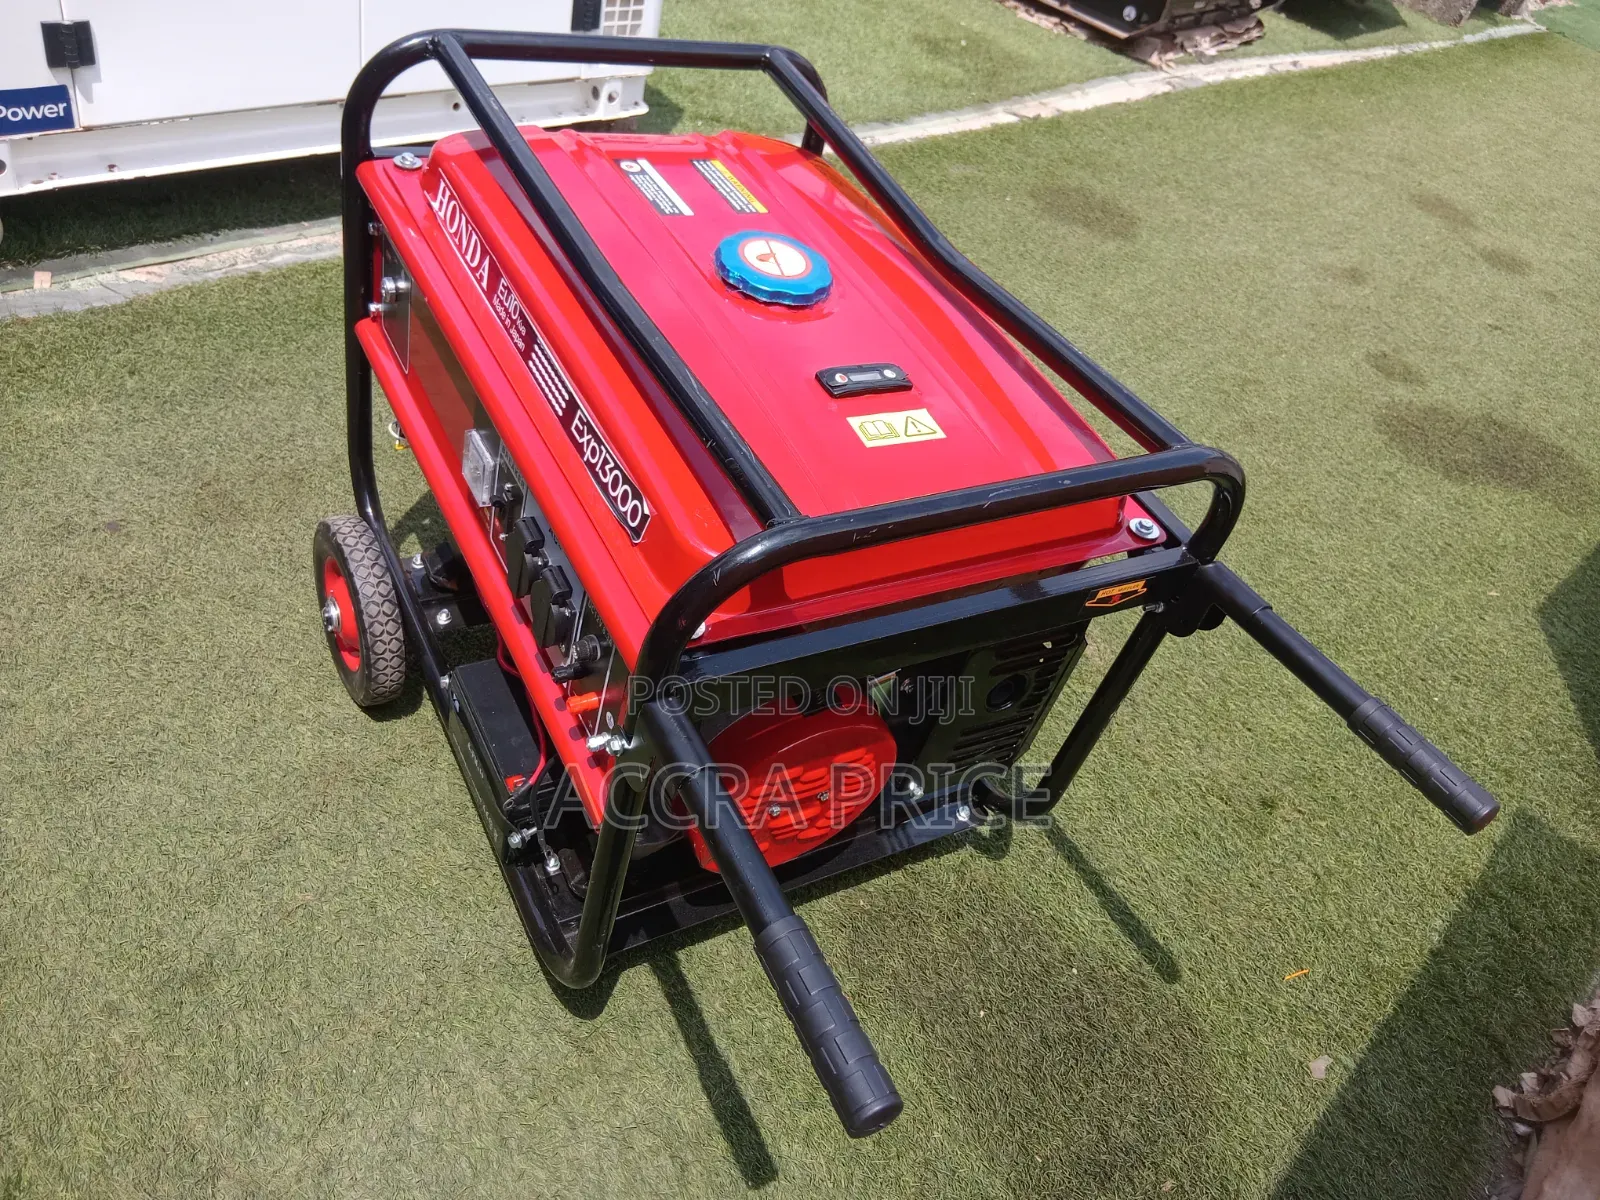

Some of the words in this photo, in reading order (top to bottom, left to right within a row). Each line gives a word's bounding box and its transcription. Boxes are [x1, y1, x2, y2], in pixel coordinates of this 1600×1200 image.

[433, 178, 490, 292] HONDA
[492, 293, 507, 321] Made
[509, 323, 526, 352] Japan
[571, 408, 642, 527] Exp13000
